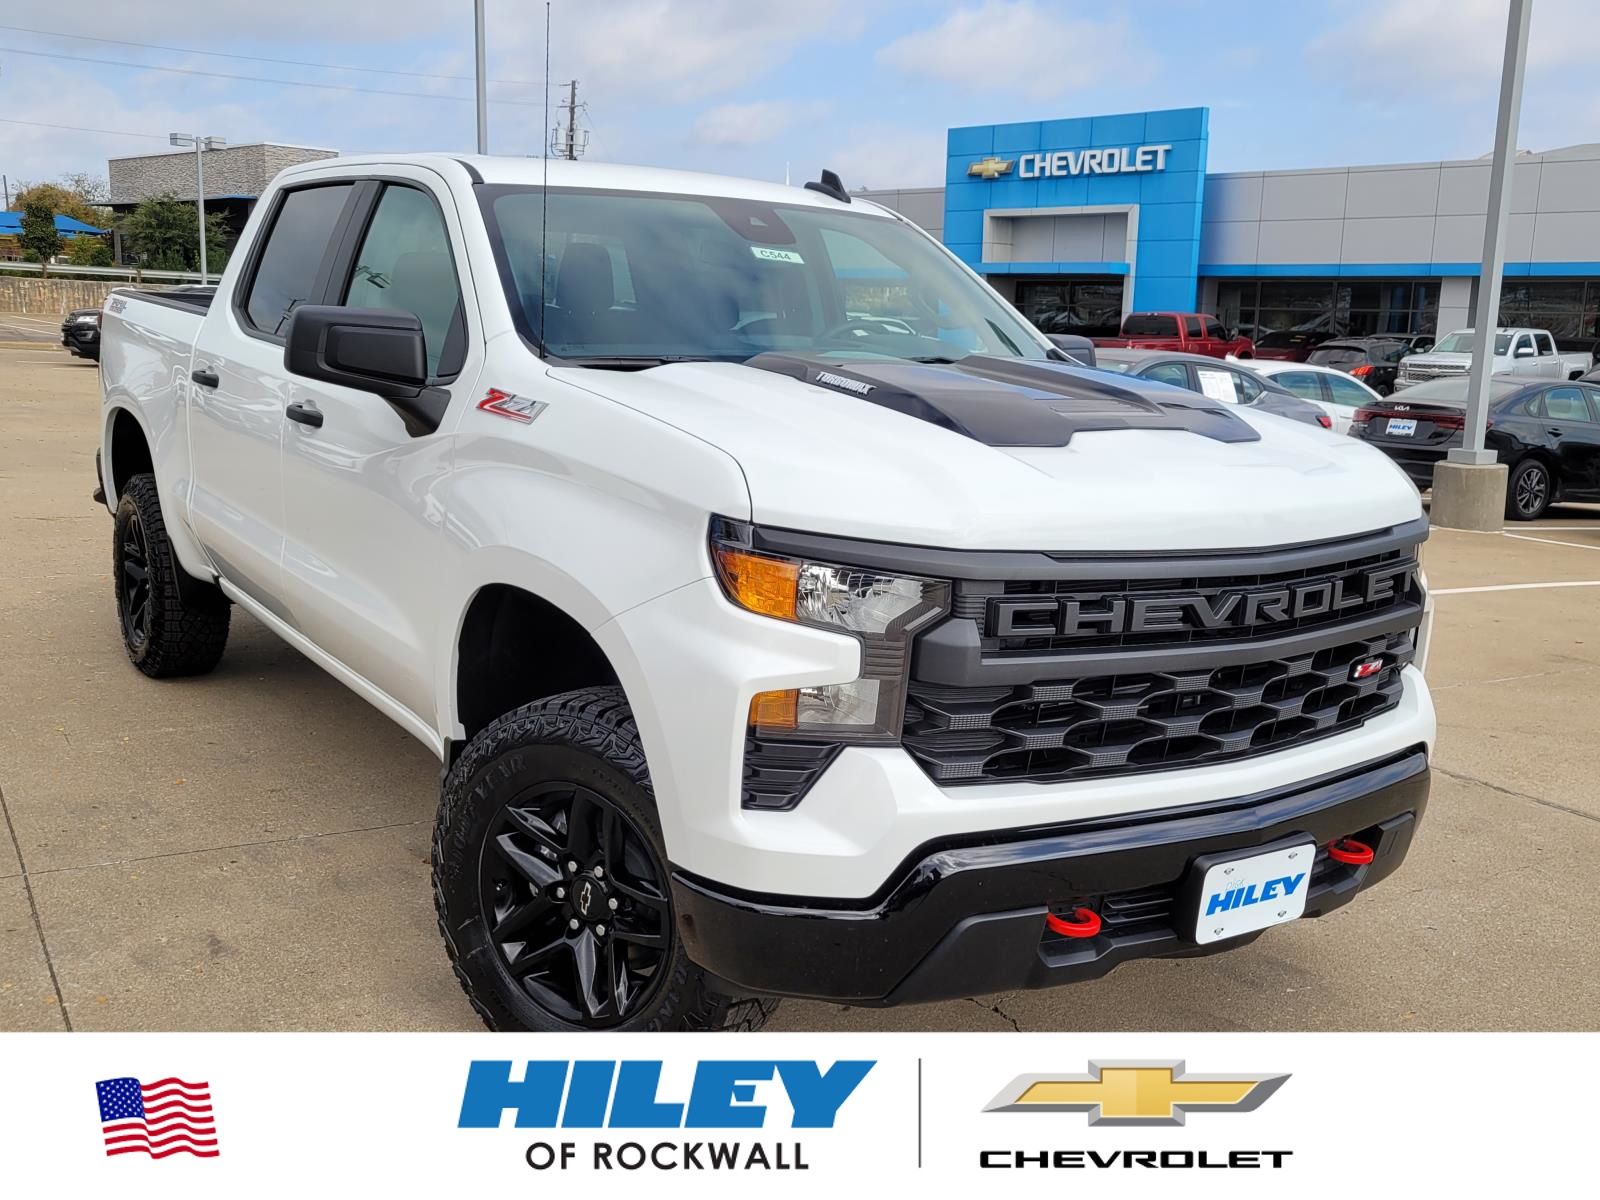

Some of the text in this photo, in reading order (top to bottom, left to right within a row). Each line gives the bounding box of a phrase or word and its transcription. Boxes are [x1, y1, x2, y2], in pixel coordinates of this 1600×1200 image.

[1018, 144, 1172, 178] CHEVROLET
[760, 250, 792, 260] C544
[476, 388, 550, 425] Z71
[993, 561, 1419, 637] CHEVROLET
[1205, 872, 1307, 917] HILEY
